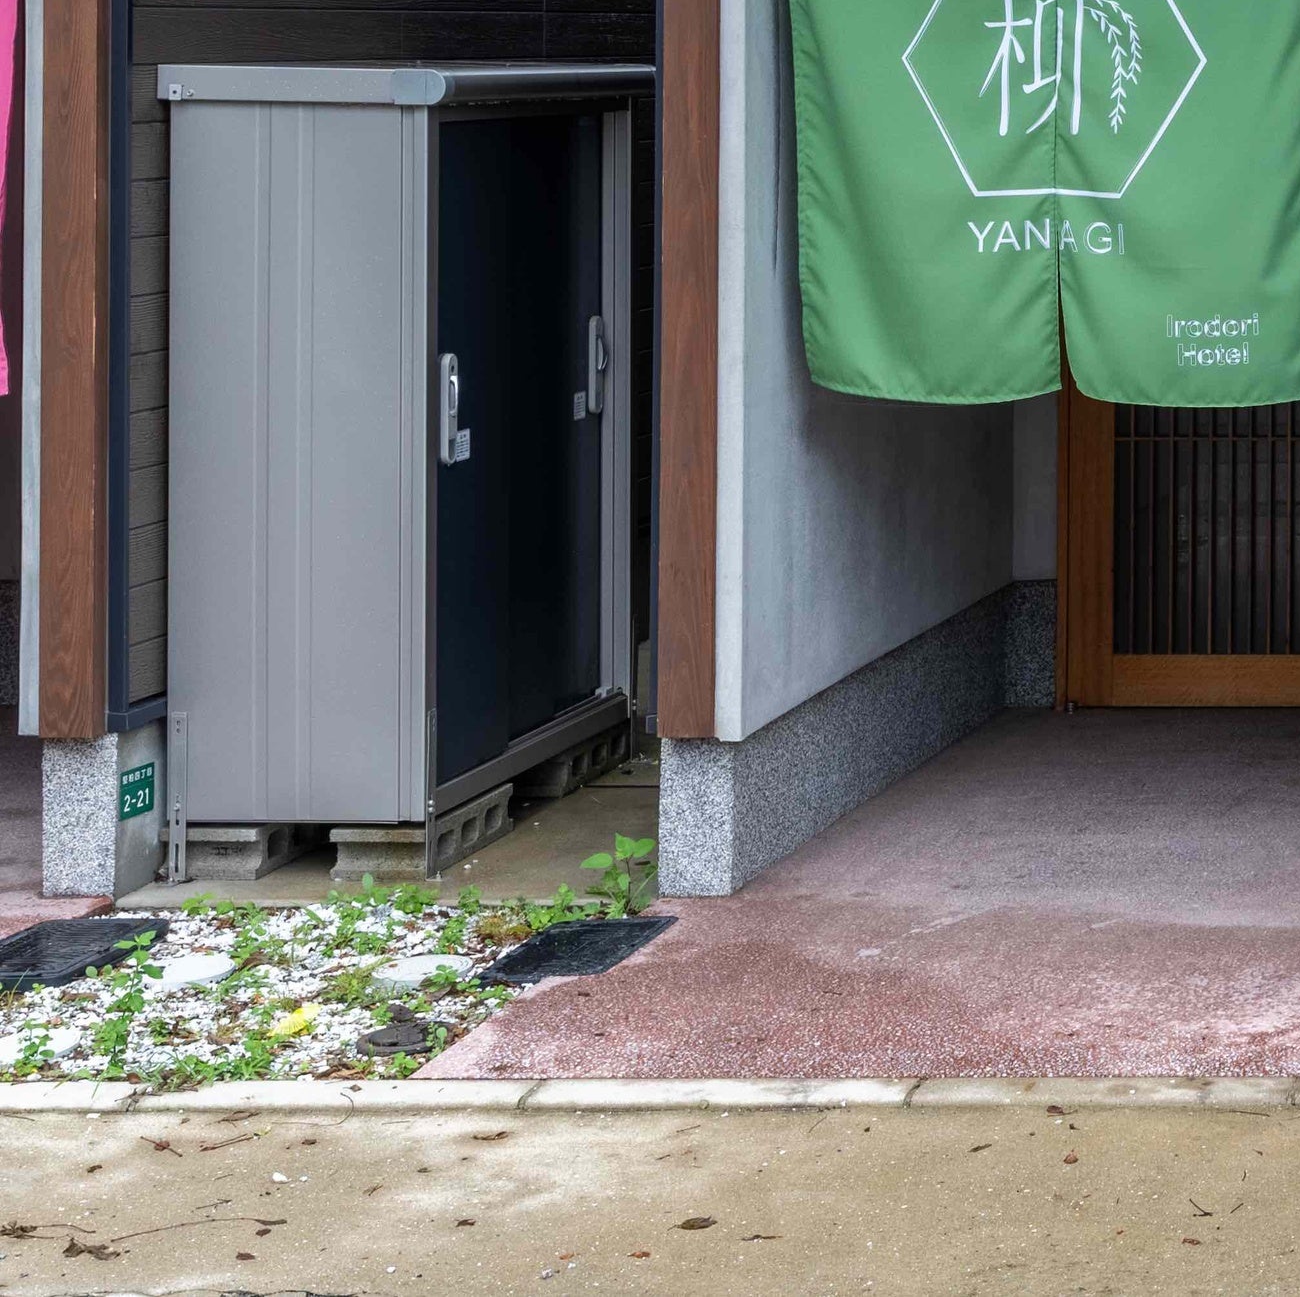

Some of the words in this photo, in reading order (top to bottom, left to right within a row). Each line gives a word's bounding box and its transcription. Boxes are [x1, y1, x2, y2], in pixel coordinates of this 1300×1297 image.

[968, 218, 1125, 255] YANAGI
[1166, 312, 1260, 338] Irodori
[1177, 341, 1249, 366] Hotel
[123, 787, 149, 813] 2-21
